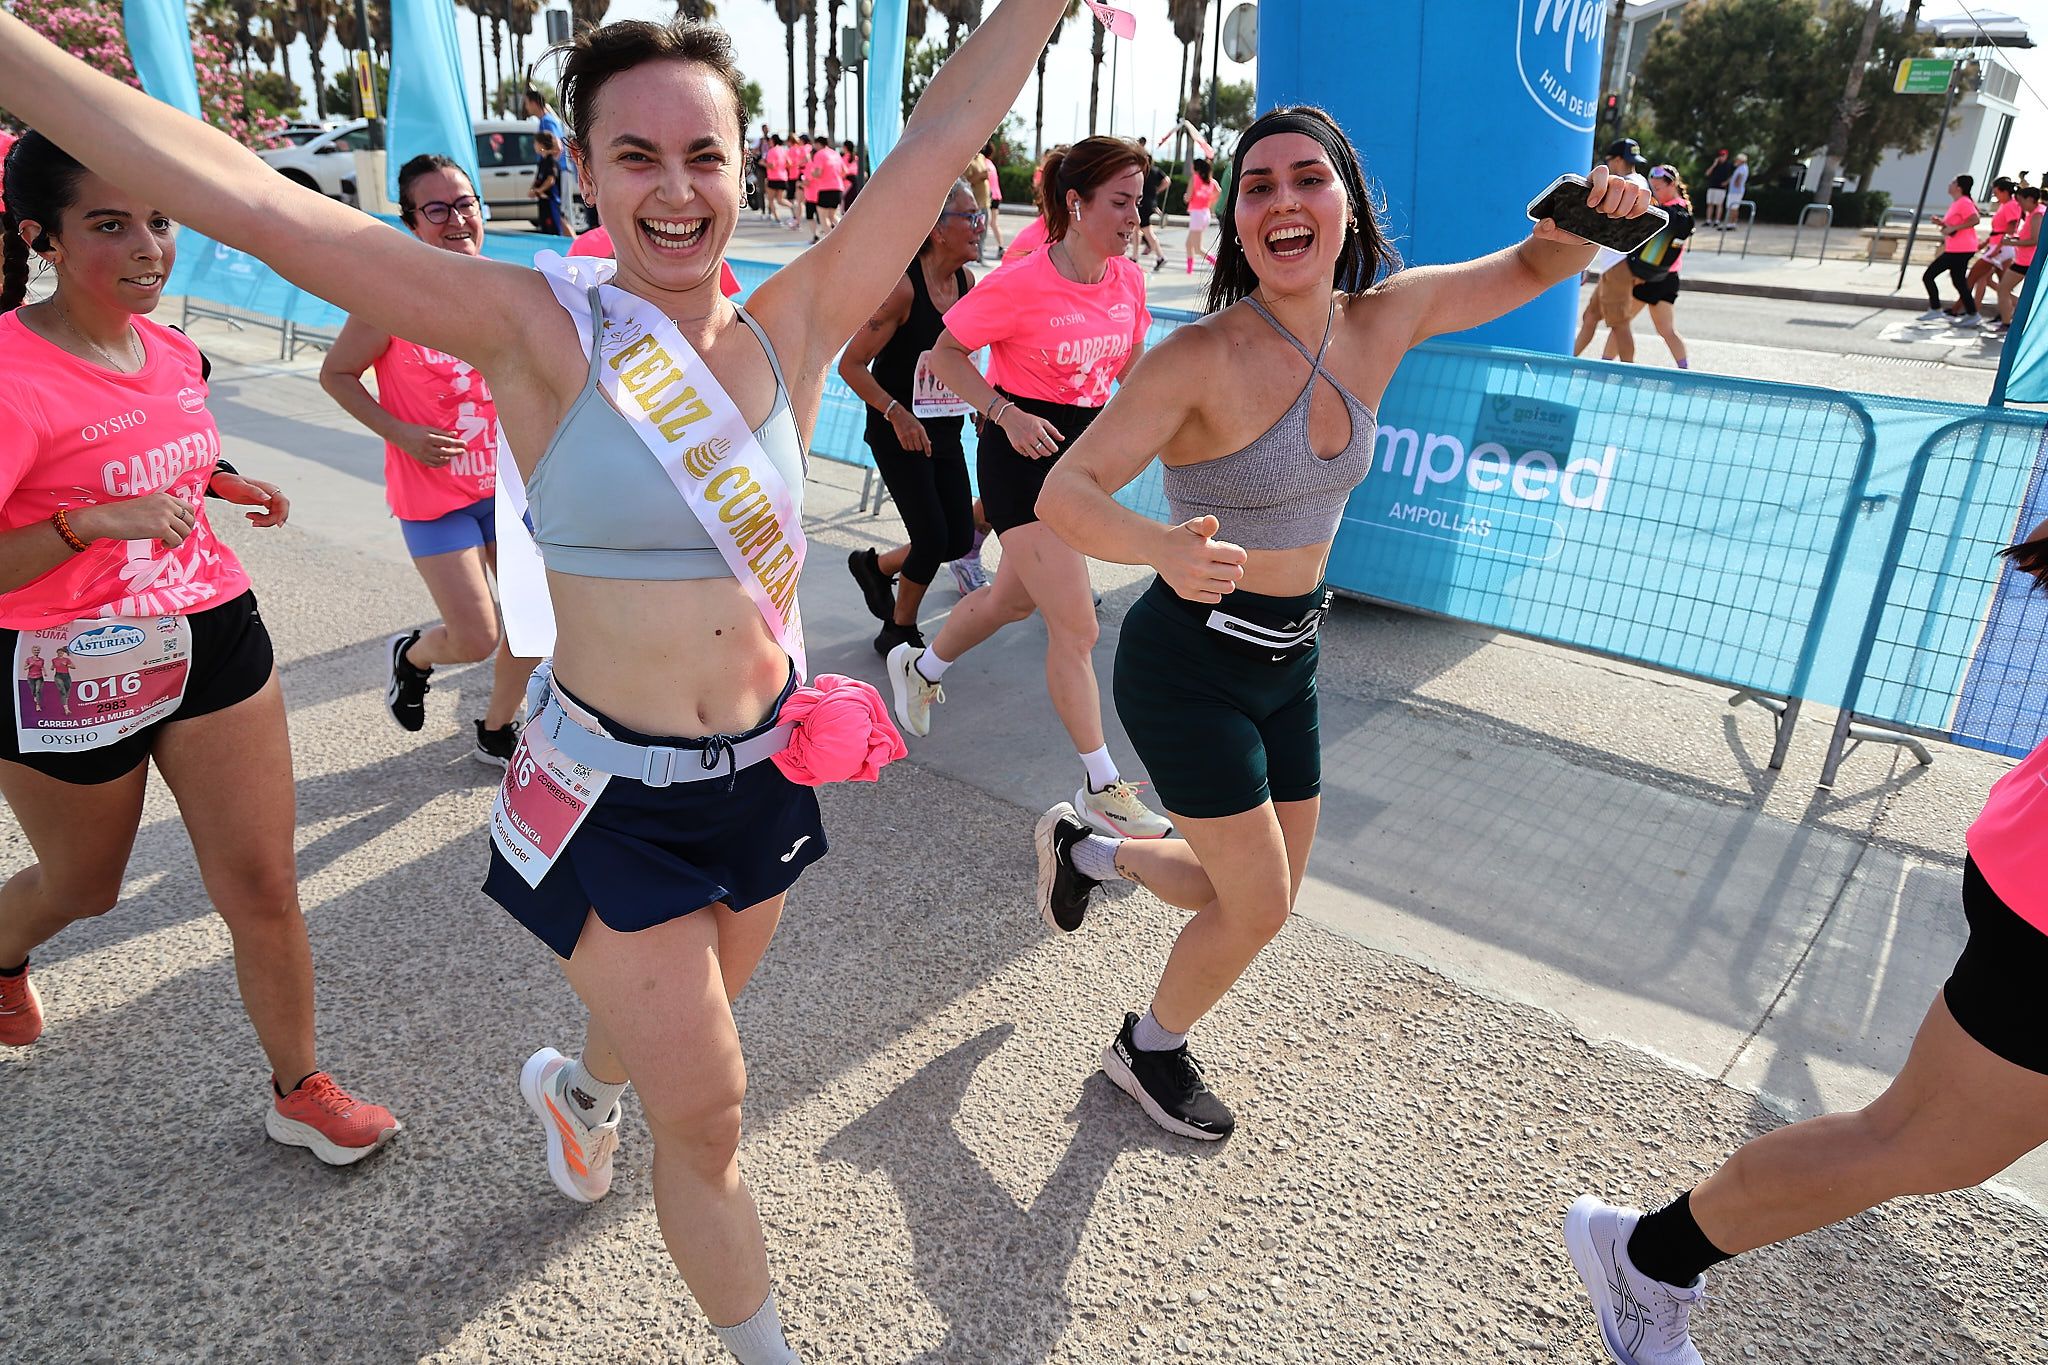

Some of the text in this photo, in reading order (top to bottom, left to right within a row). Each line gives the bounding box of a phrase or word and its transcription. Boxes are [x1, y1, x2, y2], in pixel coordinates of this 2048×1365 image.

[1539, 68, 1567, 107] HIJA
[1568, 95, 1583, 116] DE
[608, 333, 713, 444] FELIZ
[81, 409, 146, 441] OYSHO
[1388, 502, 1492, 537] AMPOLLAS
[35, 630, 67, 640] SUMA
[74, 635, 140, 652] ASTURIANA
[77, 672, 141, 702] 016
[38, 719, 78, 728] CARRERA
[82, 718, 93, 726] DE
[95, 715, 106, 724] LA
[107, 709, 135, 721] MUJER
[97, 700, 127, 713] 2983
[41, 732, 98, 745] OYSHO
[514, 737, 536, 787] 16
[496, 819, 531, 863] Santander
[510, 810, 542, 845] VALENCIA
[1115, 1039, 1133, 1069] HOKA
